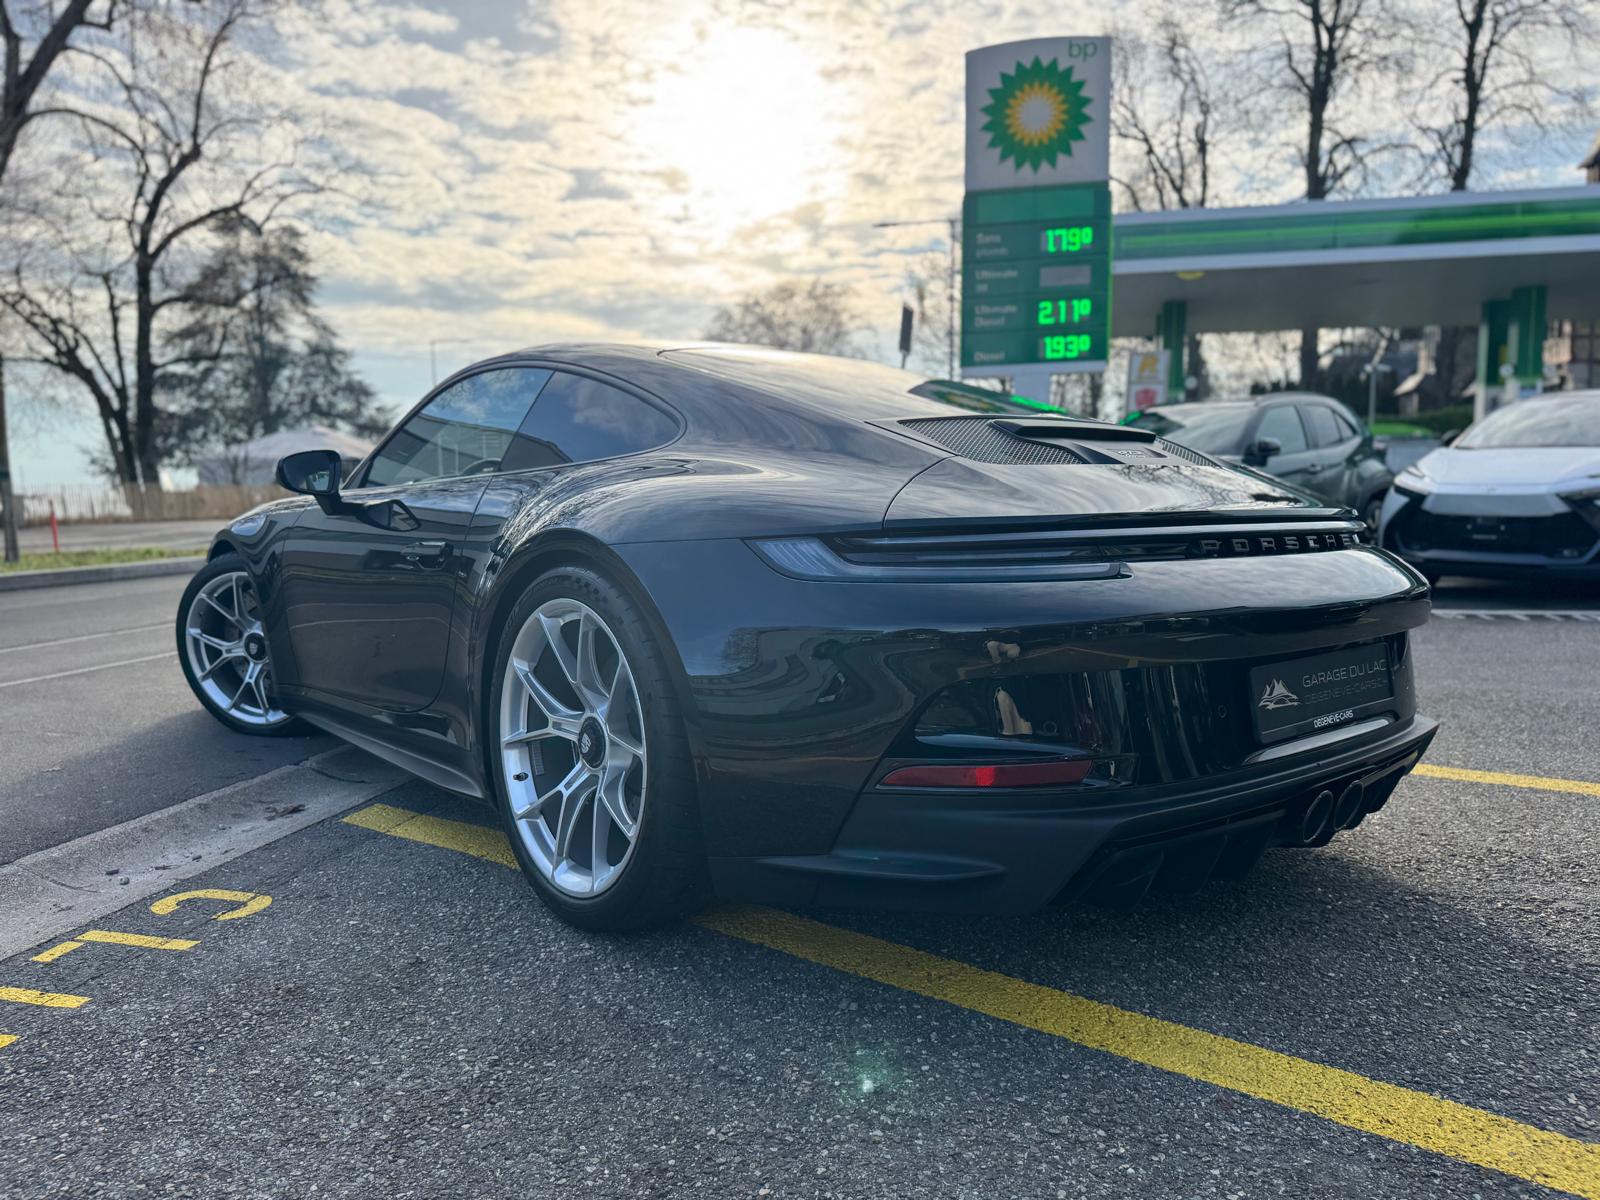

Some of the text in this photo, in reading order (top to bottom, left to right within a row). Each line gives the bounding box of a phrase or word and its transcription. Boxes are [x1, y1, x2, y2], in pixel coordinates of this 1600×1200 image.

[1068, 39, 1098, 62] bp
[1200, 533, 1350, 552] PORSCHE
[1302, 659, 1387, 687] GARAGE DU LAC
[1313, 710, 1354, 728] DEGENEVE-CARS
